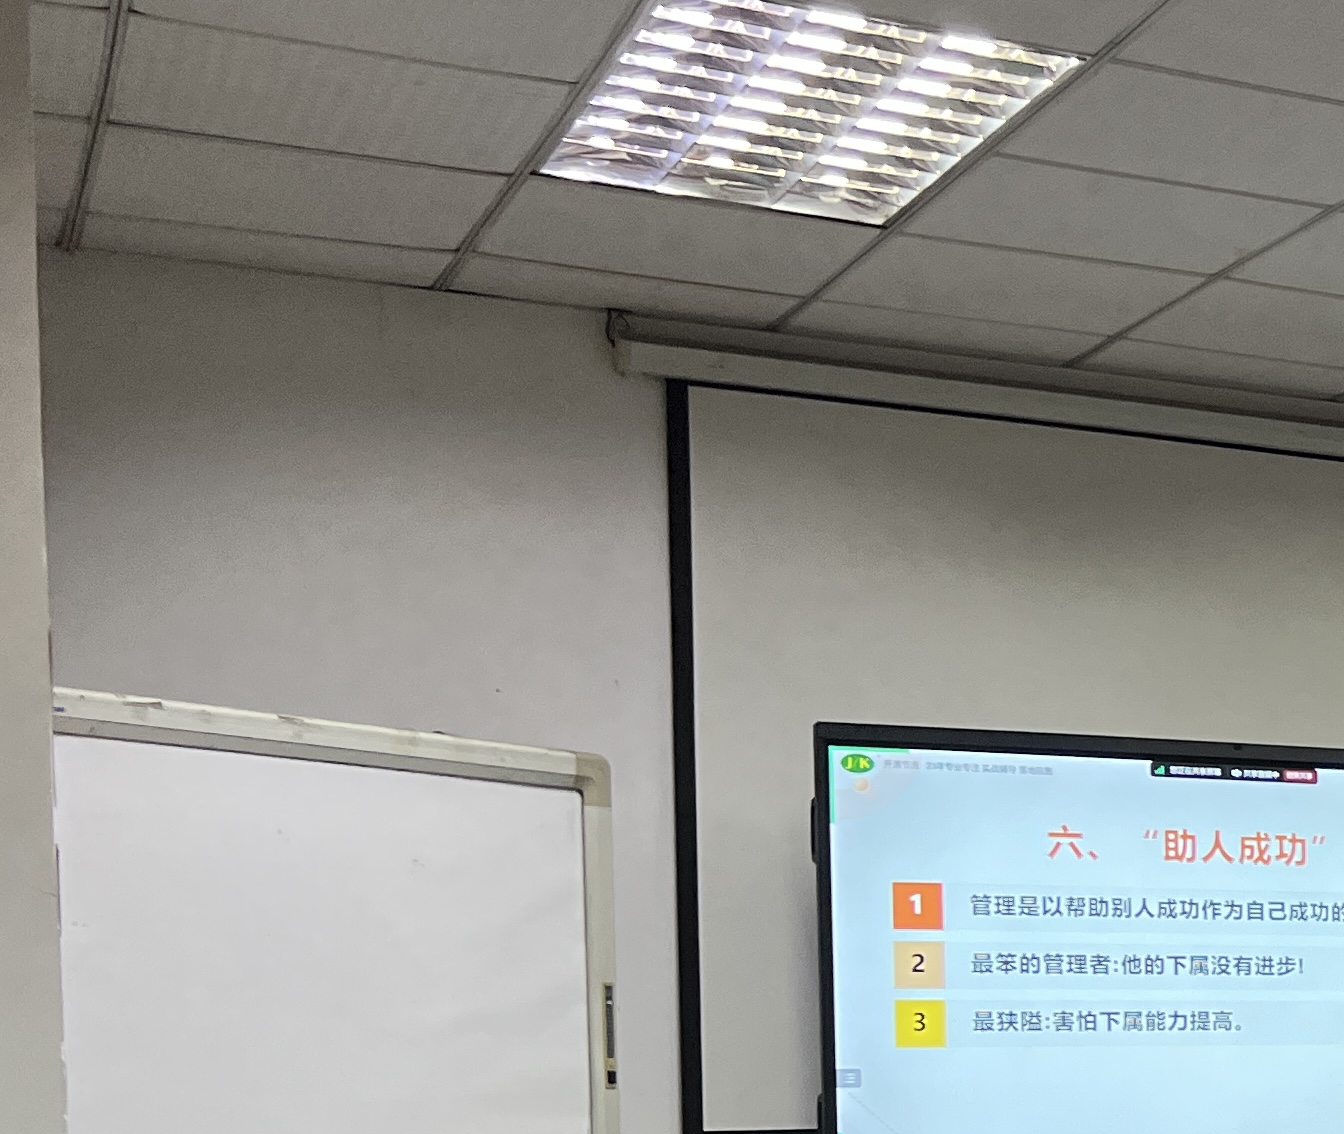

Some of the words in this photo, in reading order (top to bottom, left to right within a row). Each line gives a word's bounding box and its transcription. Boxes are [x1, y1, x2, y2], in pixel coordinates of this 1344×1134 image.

[907, 893, 924, 916] 1
[910, 952, 926, 975] 2
[912, 1011, 927, 1034] 3
